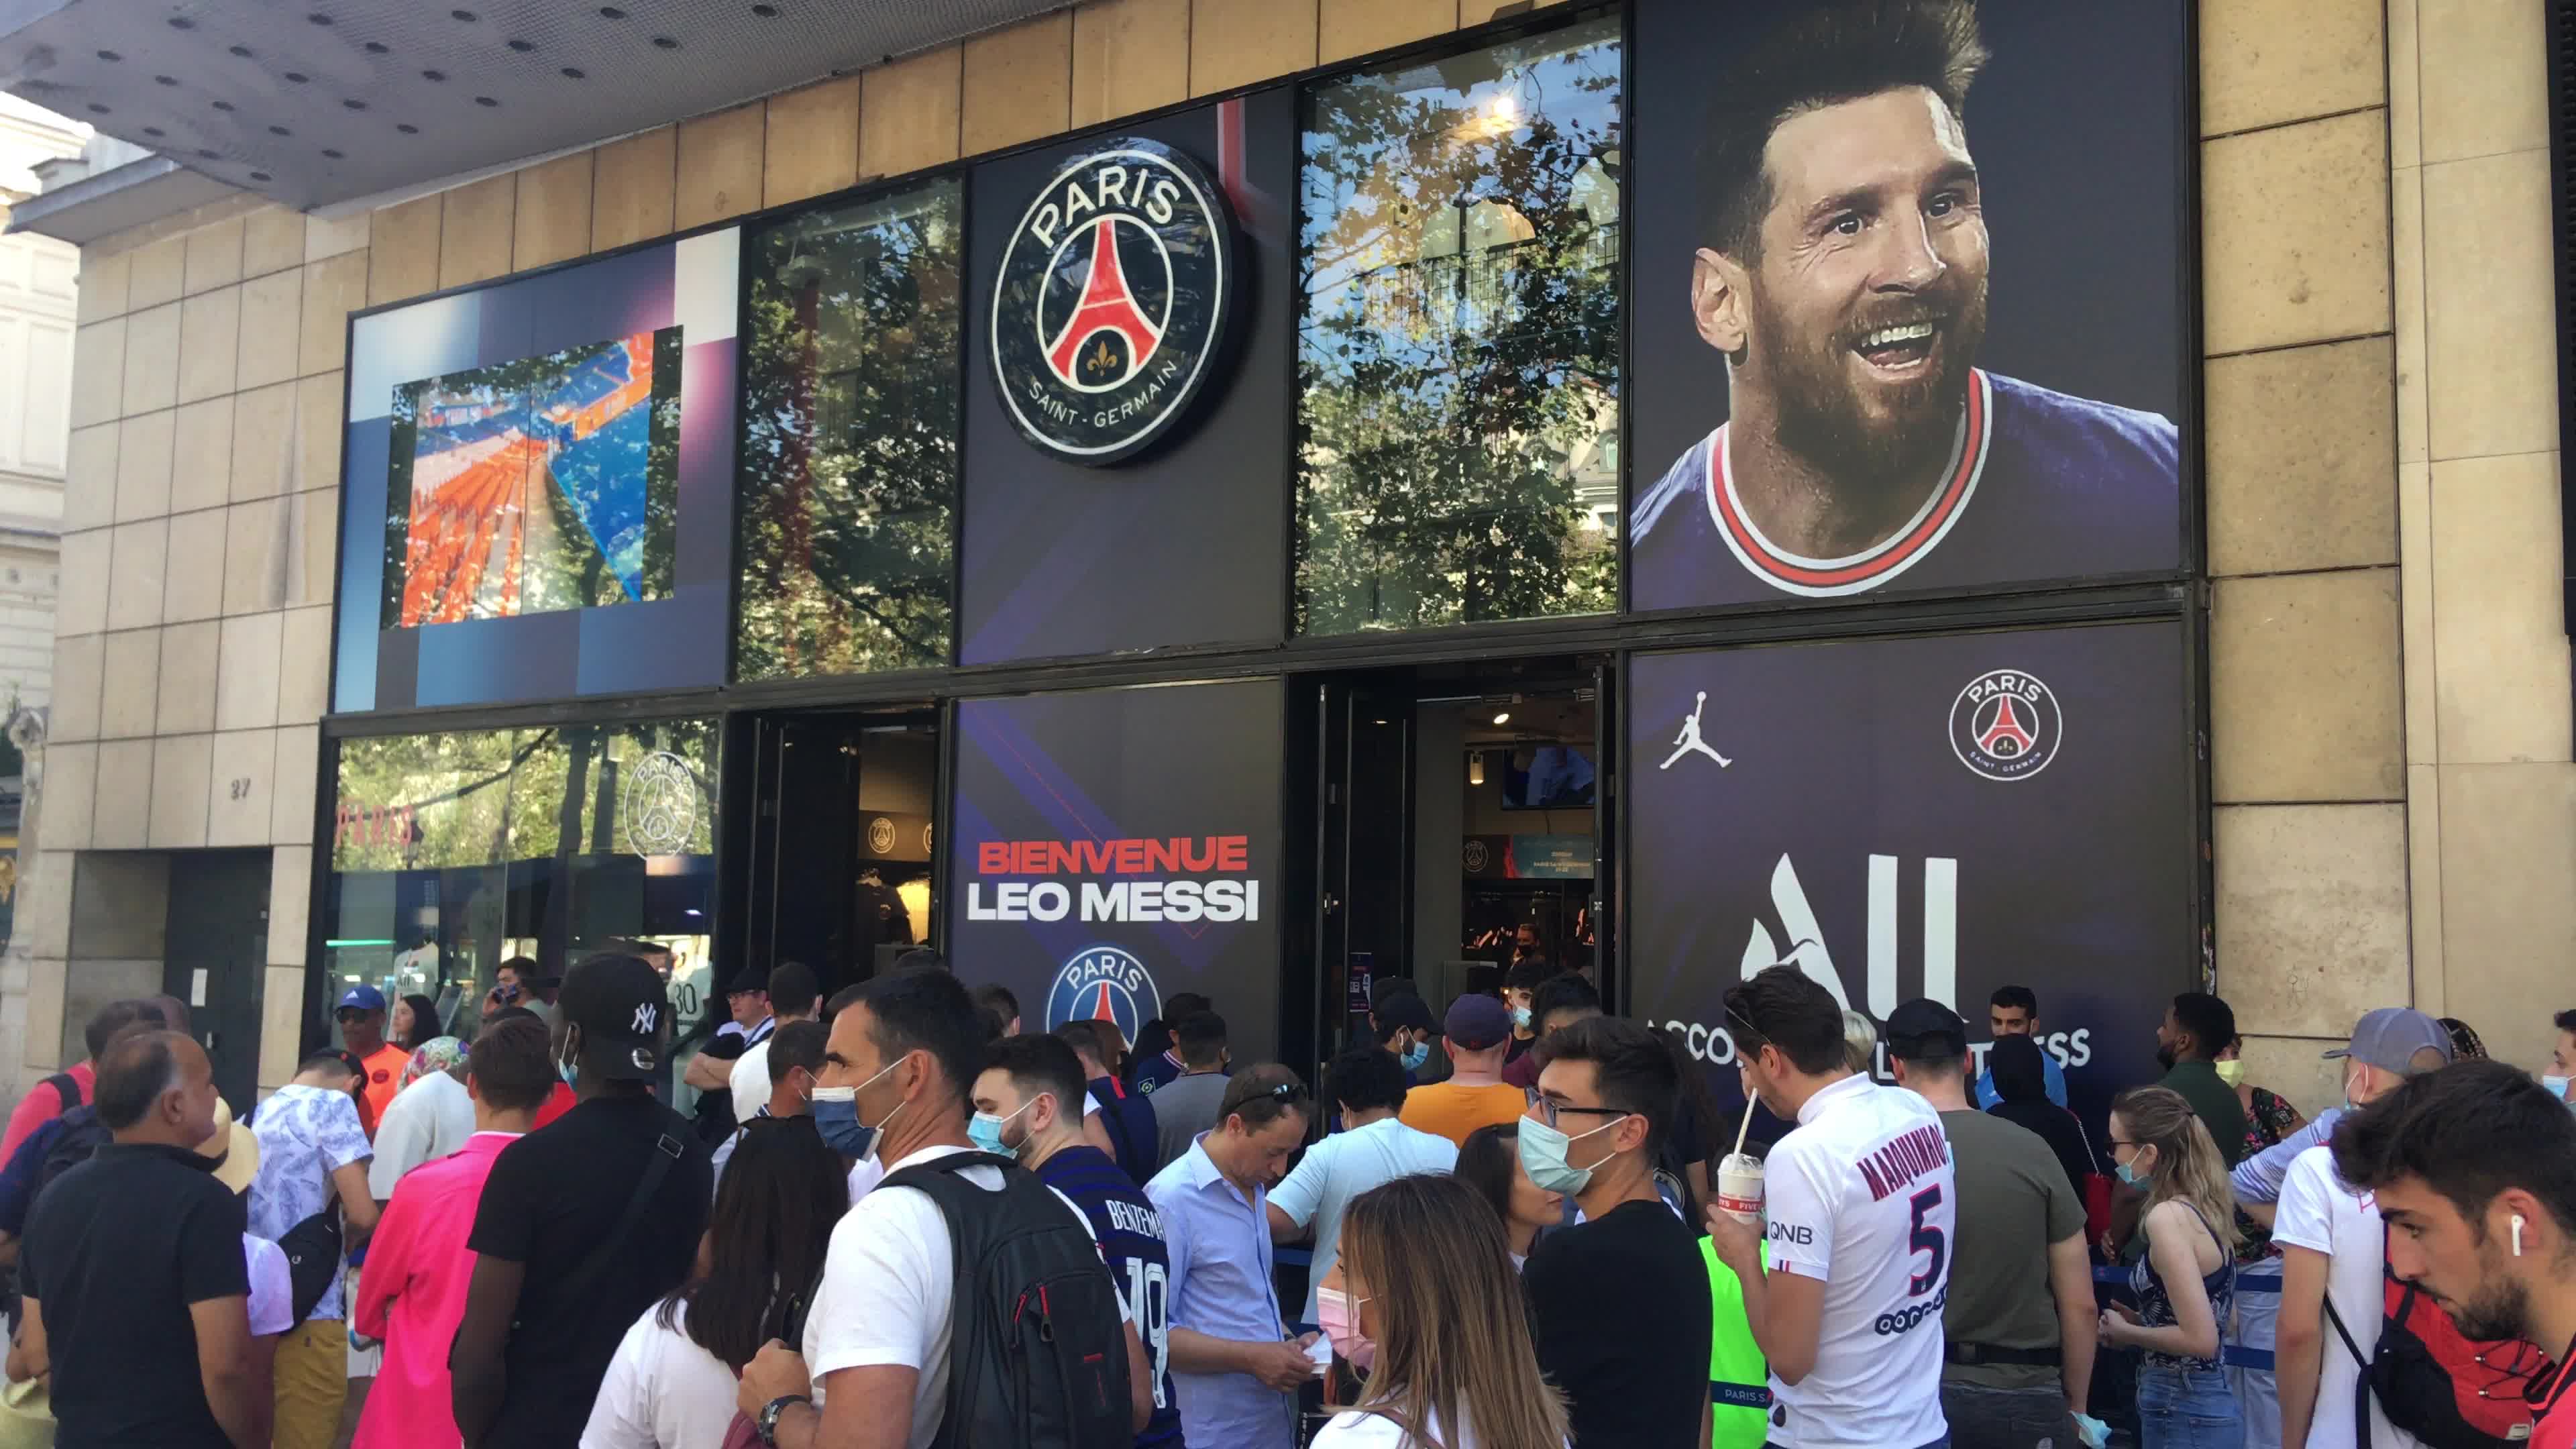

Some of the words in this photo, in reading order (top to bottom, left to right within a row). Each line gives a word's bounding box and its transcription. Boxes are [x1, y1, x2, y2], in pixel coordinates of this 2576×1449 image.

[1030, 165, 1181, 248] PARIS
[1029, 380, 1078, 425] SAINT
[1094, 359, 1177, 428] GERMAIN
[1968, 675, 2042, 704] PARIS
[637, 756, 686, 784] PARIS
[1970, 751, 1995, 769] SAINT
[2002, 751, 2041, 771] GERMAIN
[335, 804, 413, 849] PARIS
[979, 836, 1248, 874] BIENVENUE
[967, 882, 1070, 922] LEO
[1081, 879, 1259, 922] MESSI
[1066, 955, 1142, 992] PARIS
[676, 983, 697, 1014] 30
[1856, 1123, 1949, 1202] MARQUINHO
[1105, 1199, 1167, 1242] BENZEMA
[1770, 1221, 1813, 1245] QNB
[1909, 1183, 1945, 1297] 5
[1724, 1389, 1756, 1401] PARIS
